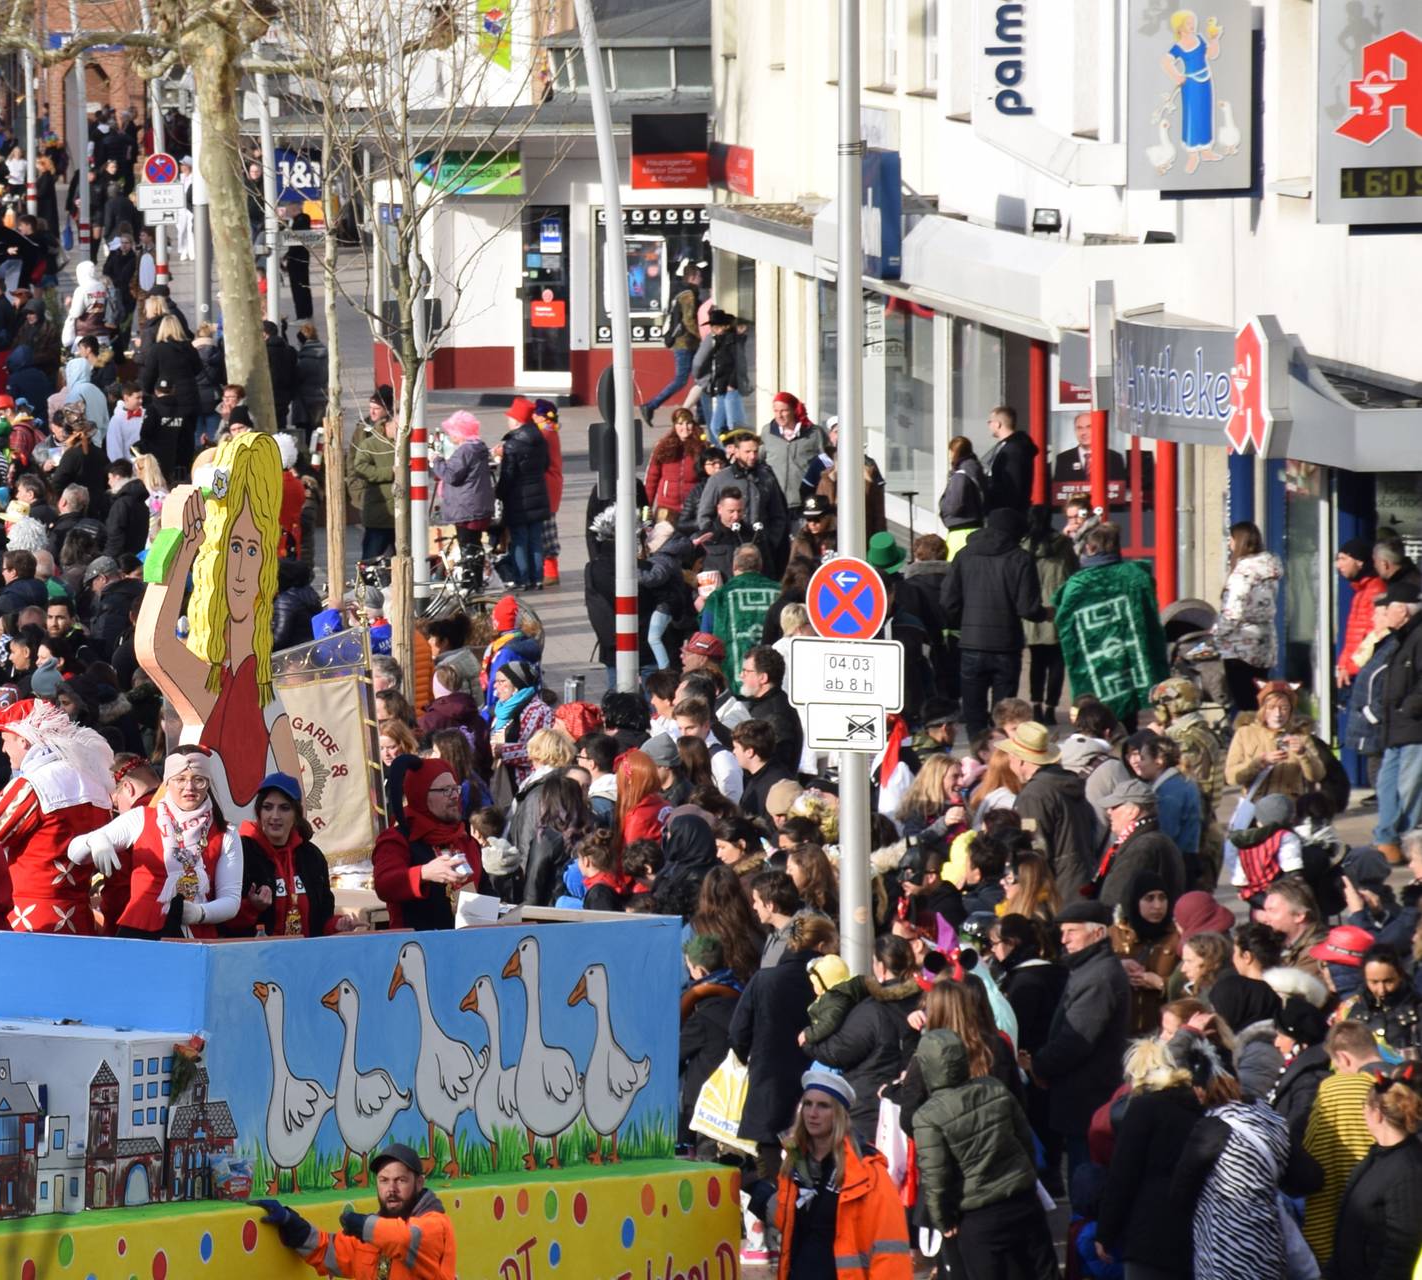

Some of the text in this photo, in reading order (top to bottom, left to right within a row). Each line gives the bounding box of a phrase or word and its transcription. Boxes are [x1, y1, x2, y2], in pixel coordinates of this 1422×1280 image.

[984, 0, 1033, 116] palm
[279, 161, 321, 188] 1&1
[1124, 340, 1231, 427] Apotheke
[829, 656, 870, 671] 04.03
[825, 676, 873, 691] ab 8 h
[291, 716, 340, 756] GARDE
[331, 764, 349, 778] 26
